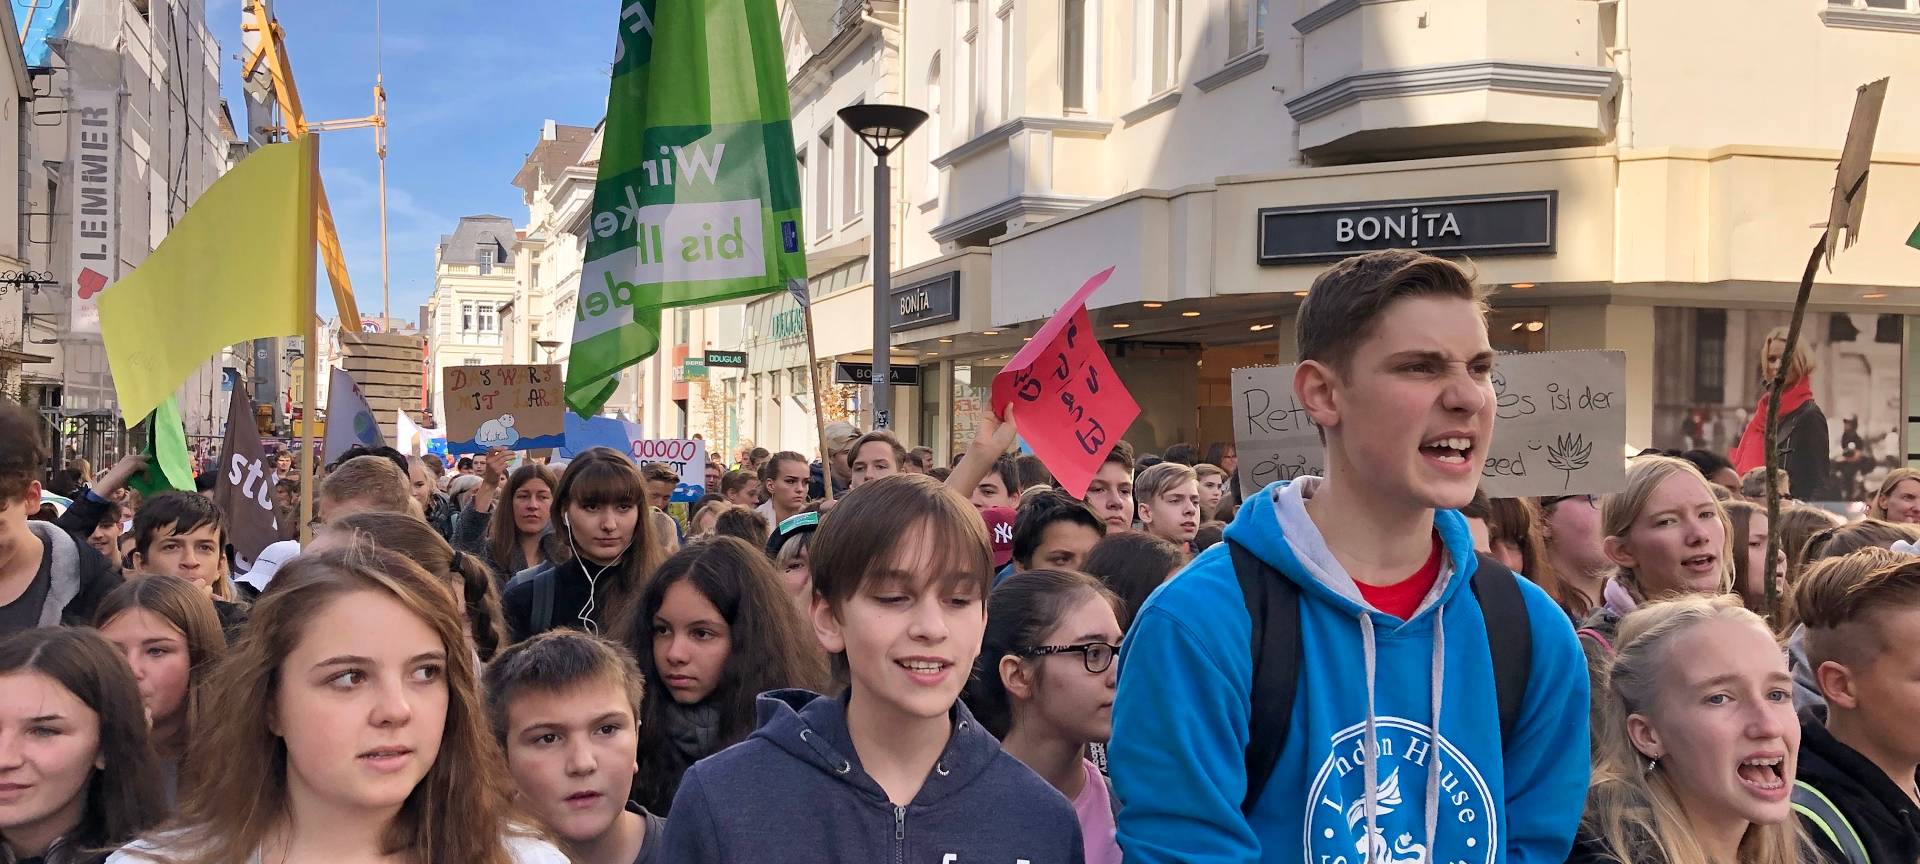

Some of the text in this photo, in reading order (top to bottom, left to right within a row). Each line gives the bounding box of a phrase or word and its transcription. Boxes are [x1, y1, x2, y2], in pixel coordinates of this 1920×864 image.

[80, 106, 108, 260] LEMMER
[709, 354, 742, 364] DOUGLAS
[856, 368, 899, 380] BOTA
[1578, 385, 1613, 411] der
